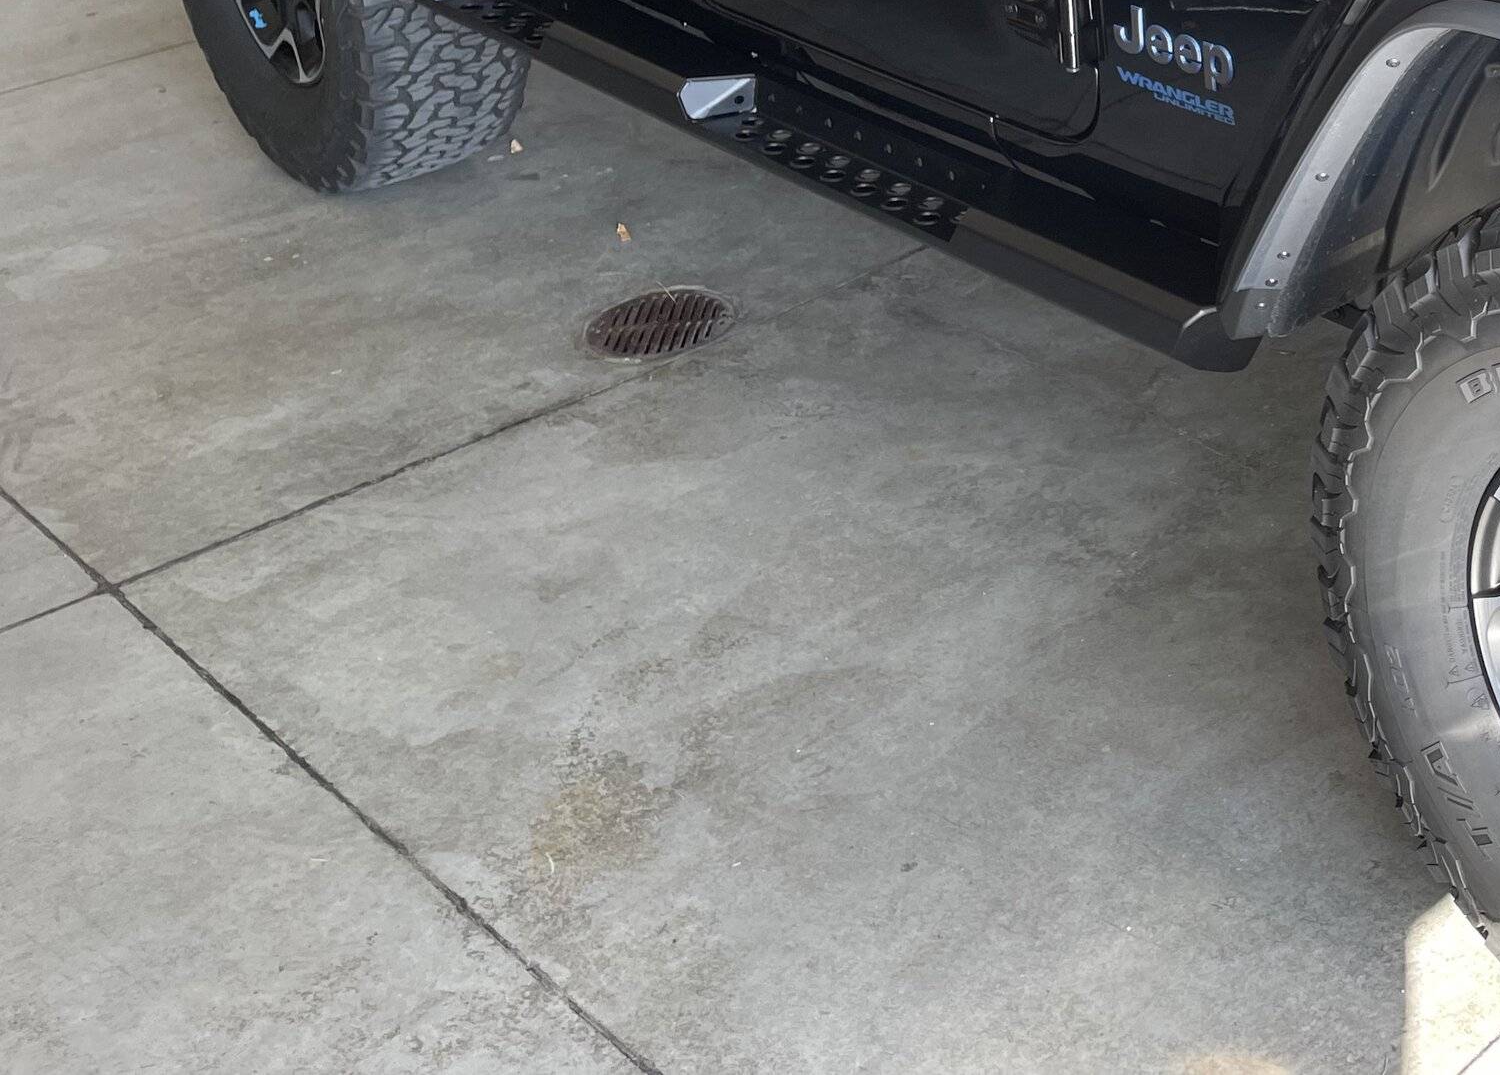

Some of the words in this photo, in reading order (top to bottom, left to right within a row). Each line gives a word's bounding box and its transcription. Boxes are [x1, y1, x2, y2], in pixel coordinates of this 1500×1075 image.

[1113, 4, 1234, 92] Jeep
[1116, 65, 1234, 116] WRANGLER
[1153, 91, 1236, 126] UNLIMITED
